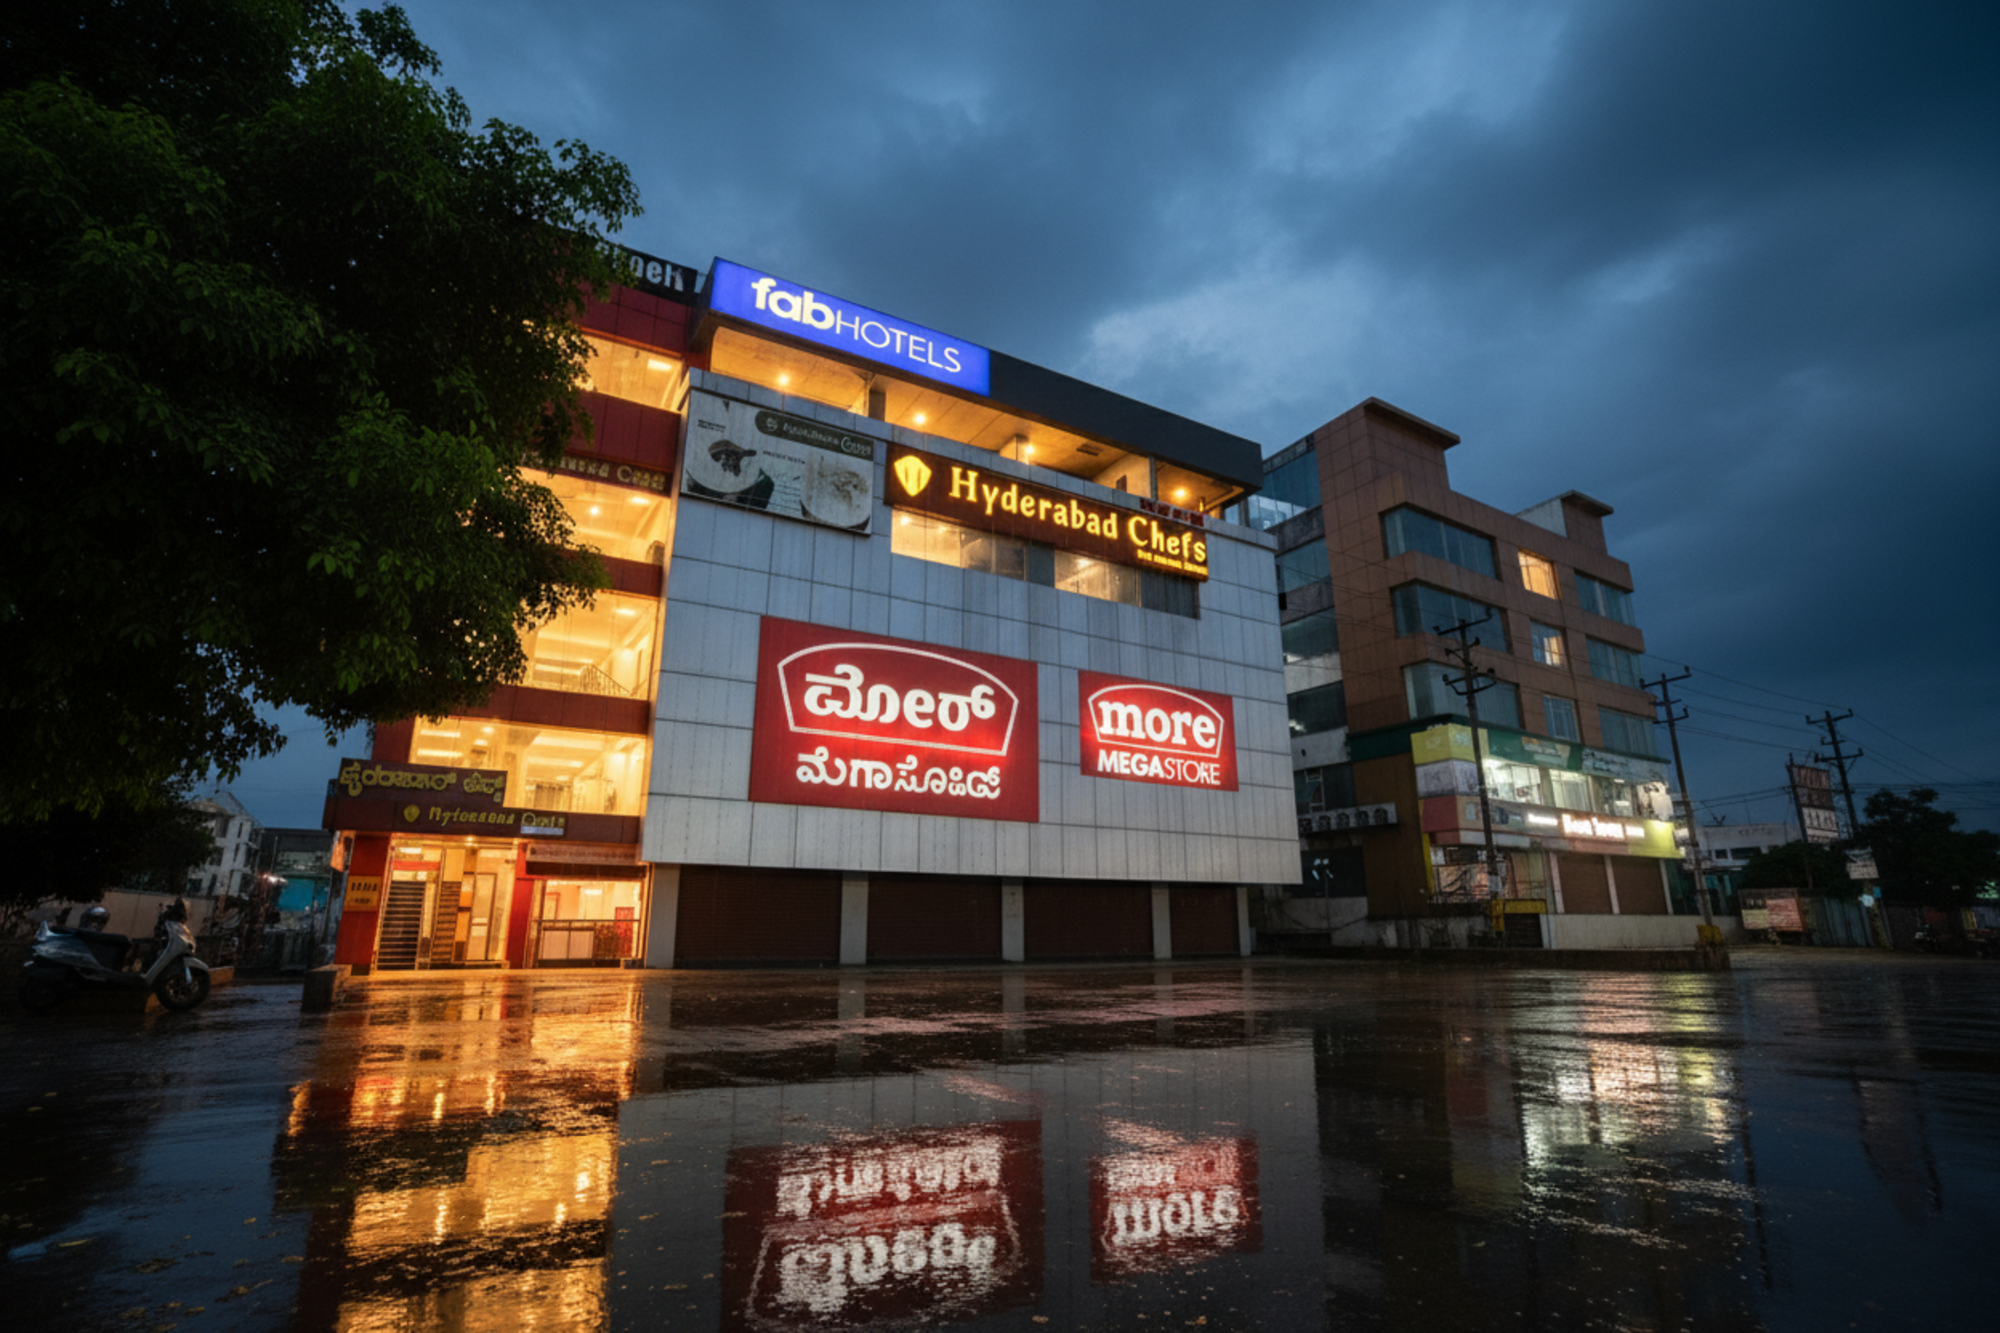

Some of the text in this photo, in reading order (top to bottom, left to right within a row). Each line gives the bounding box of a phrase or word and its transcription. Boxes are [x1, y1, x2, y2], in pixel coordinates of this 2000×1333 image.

[751, 278, 962, 373] fabHOTELS
[948, 466, 1118, 539] Hyderabad
[1127, 515, 1207, 563] Chefs
[1098, 700, 1217, 748] more
[1097, 749, 1221, 785] MEGASTORE
